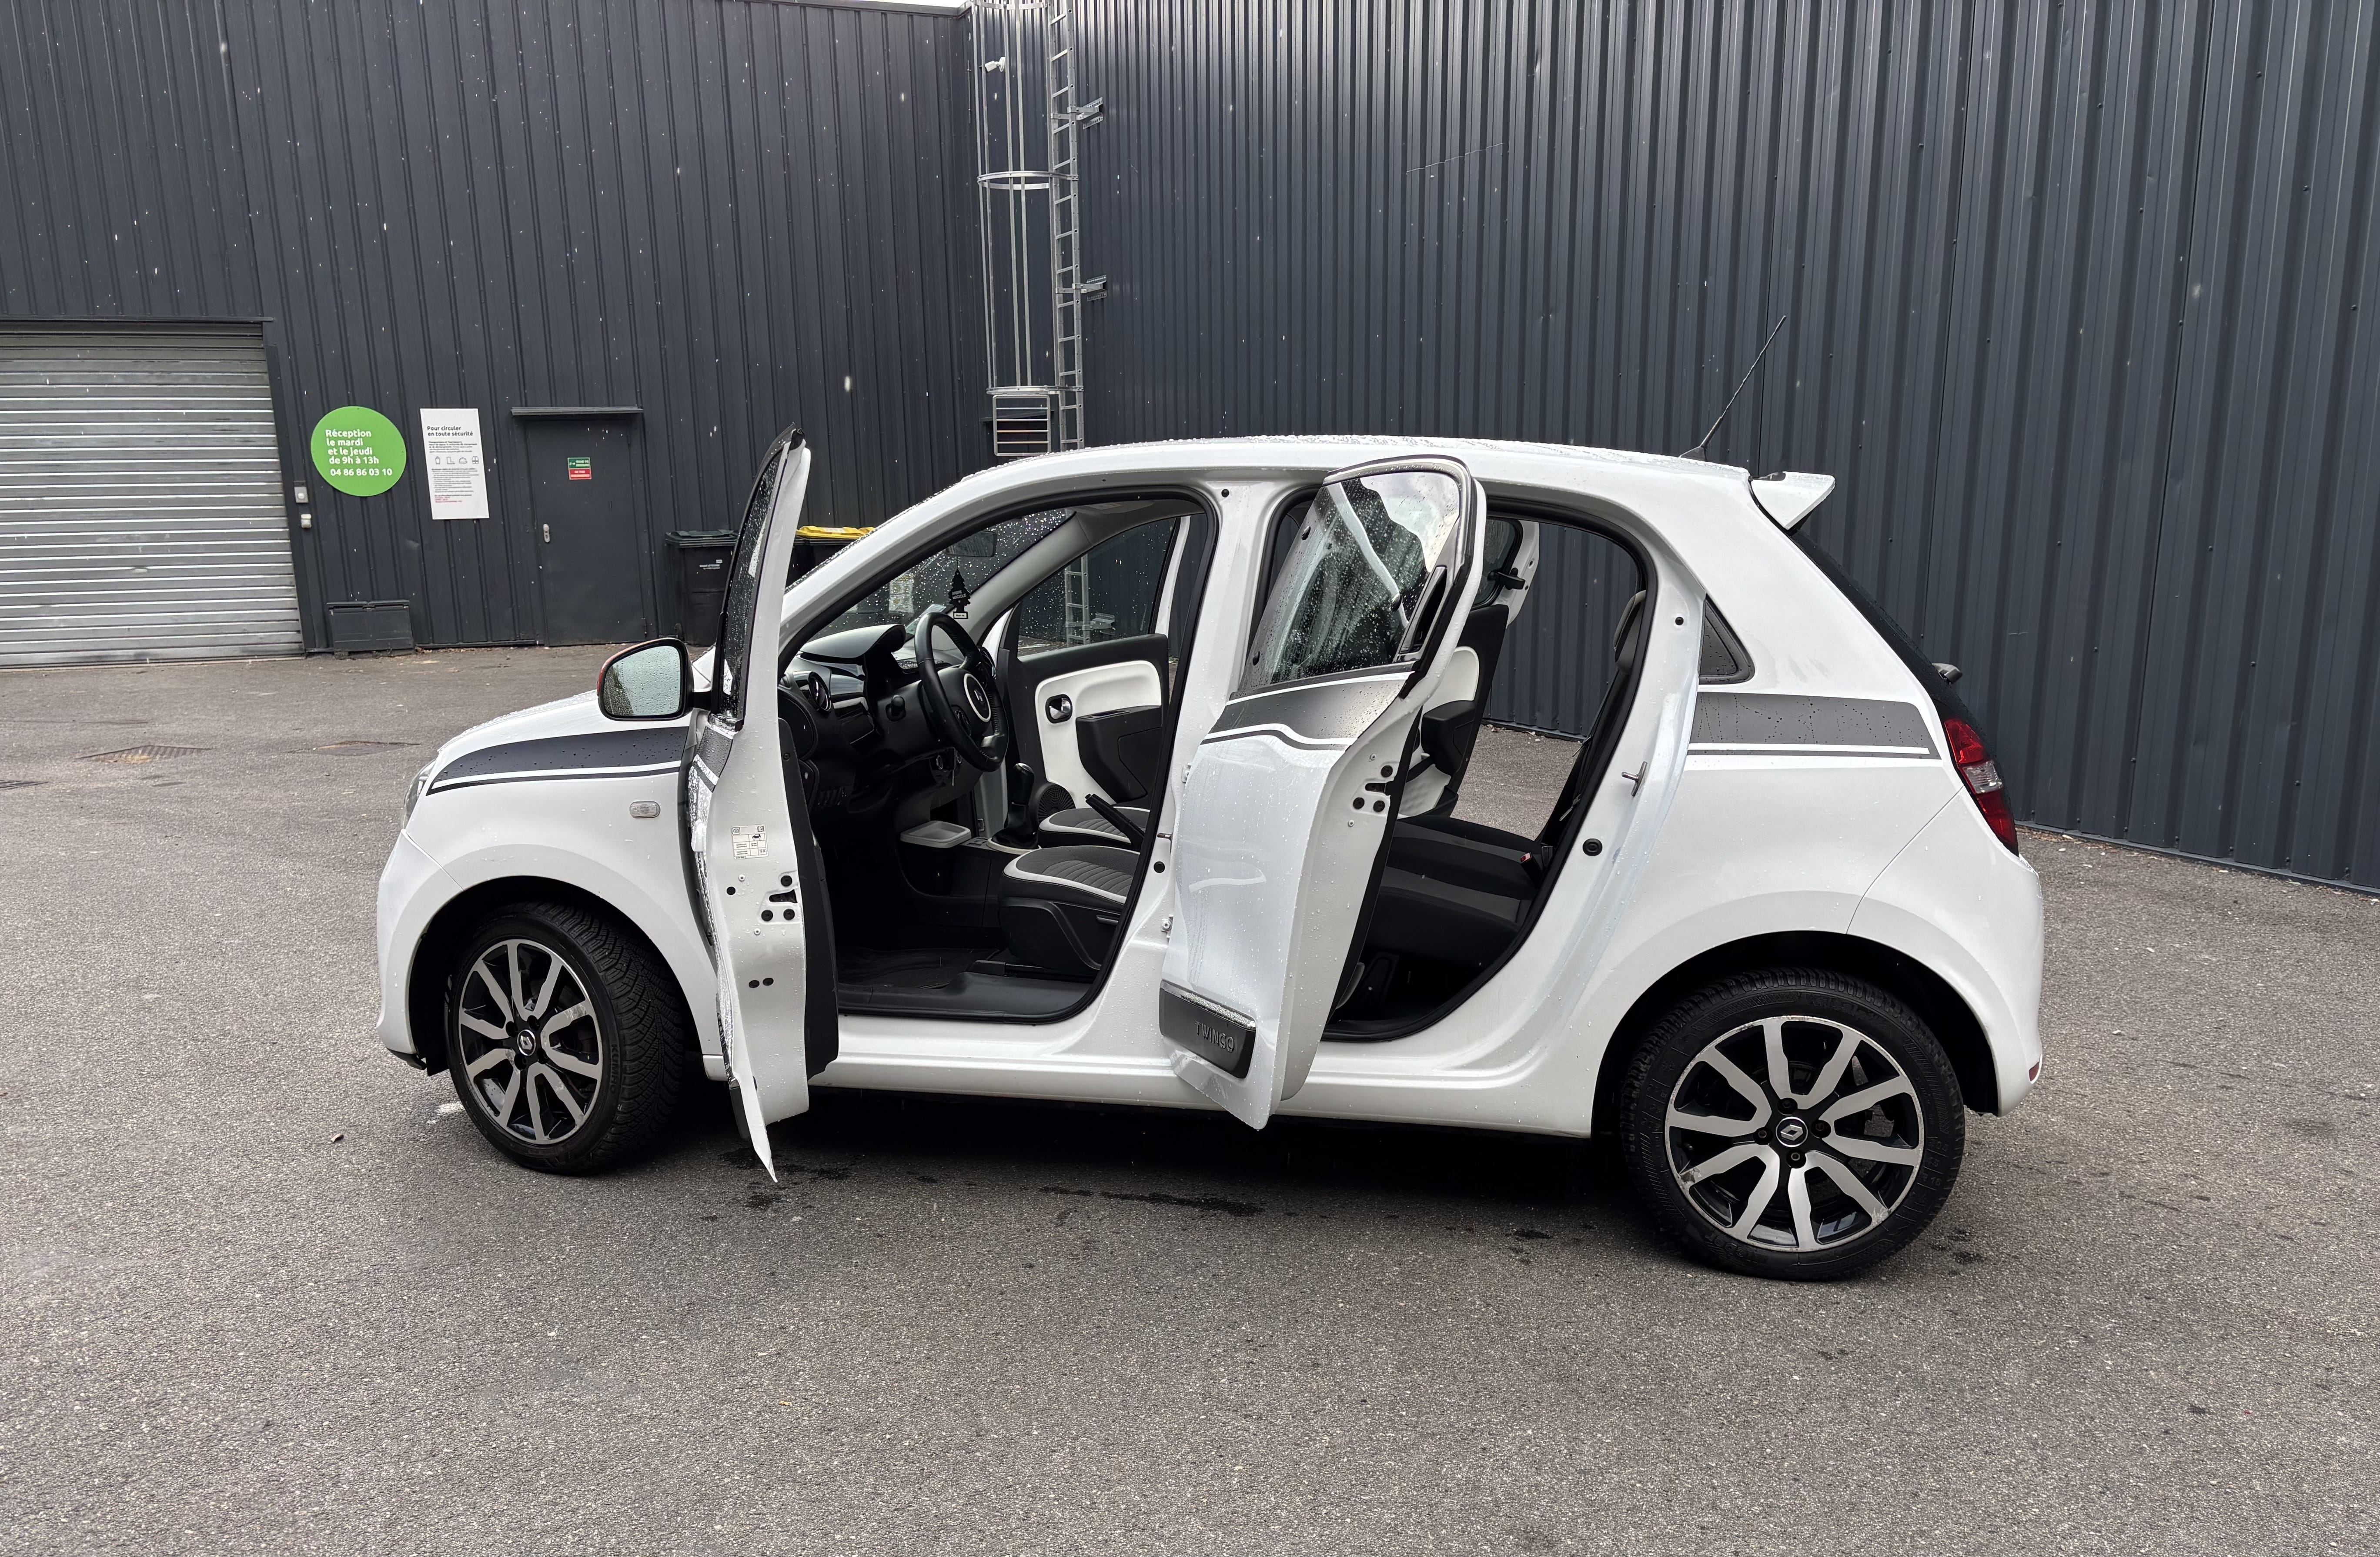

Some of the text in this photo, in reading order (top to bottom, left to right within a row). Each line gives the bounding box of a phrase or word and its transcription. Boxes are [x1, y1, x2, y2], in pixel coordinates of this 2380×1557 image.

[325, 428, 372, 439] Réception
[326, 438, 363, 446] le mardi
[339, 447, 348, 455] le
[350, 447, 373, 457] jeudi
[329, 455, 379, 464] de 9h à 13h
[1194, 1020, 1235, 1052] TWINGO
[610, 1044, 619, 1093] KUMHO
